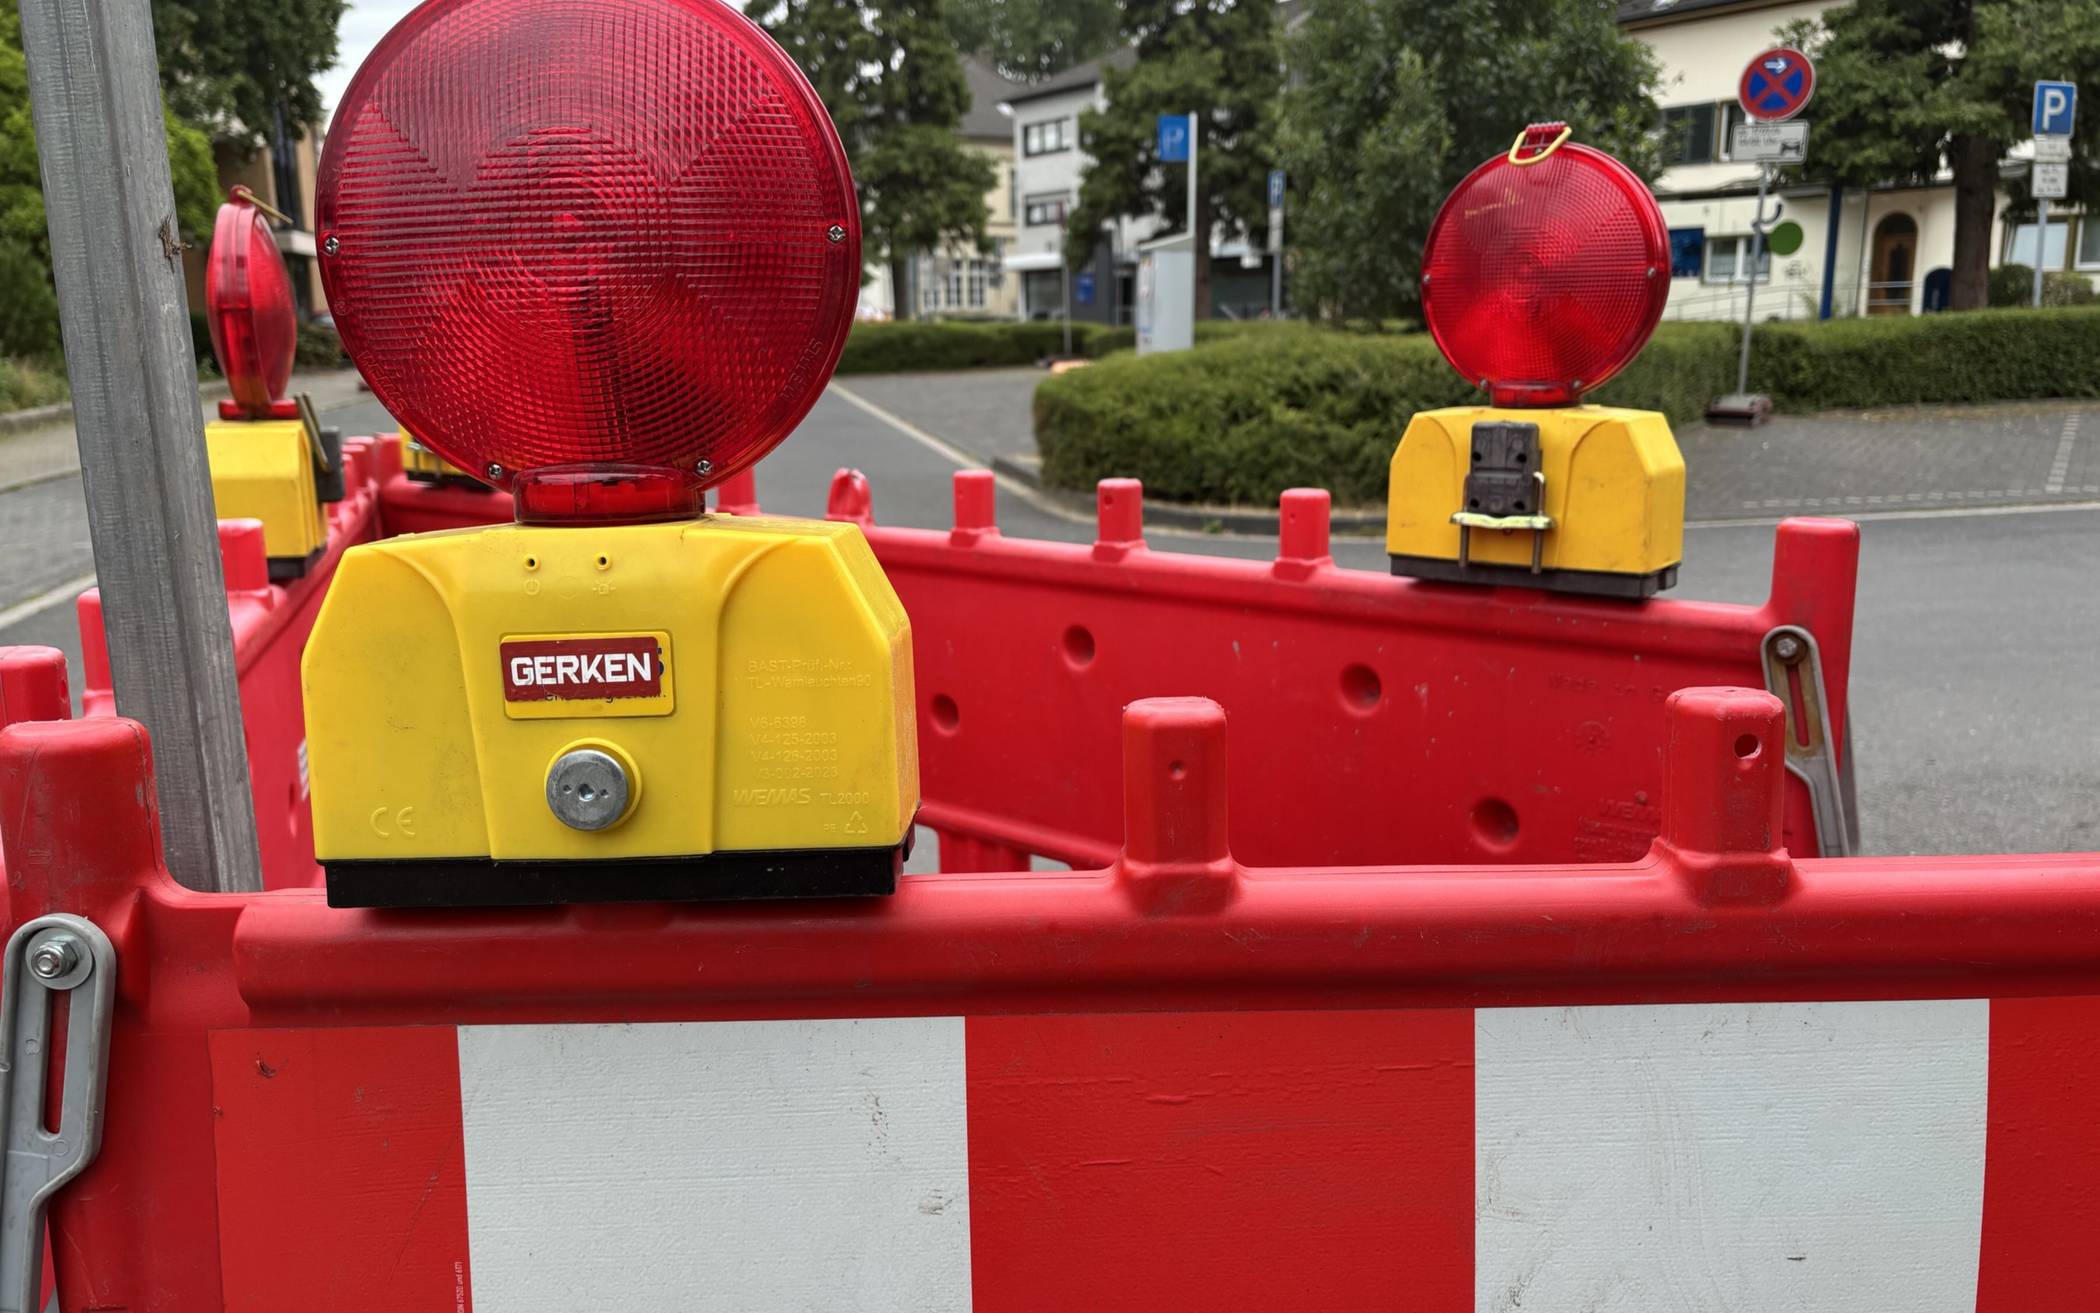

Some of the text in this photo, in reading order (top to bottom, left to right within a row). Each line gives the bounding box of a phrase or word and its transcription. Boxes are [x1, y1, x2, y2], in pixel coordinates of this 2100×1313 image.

[2042, 88, 2067, 131] P
[510, 652, 652, 687] GERKEN
[733, 787, 870, 806] WEMAS TL2000
